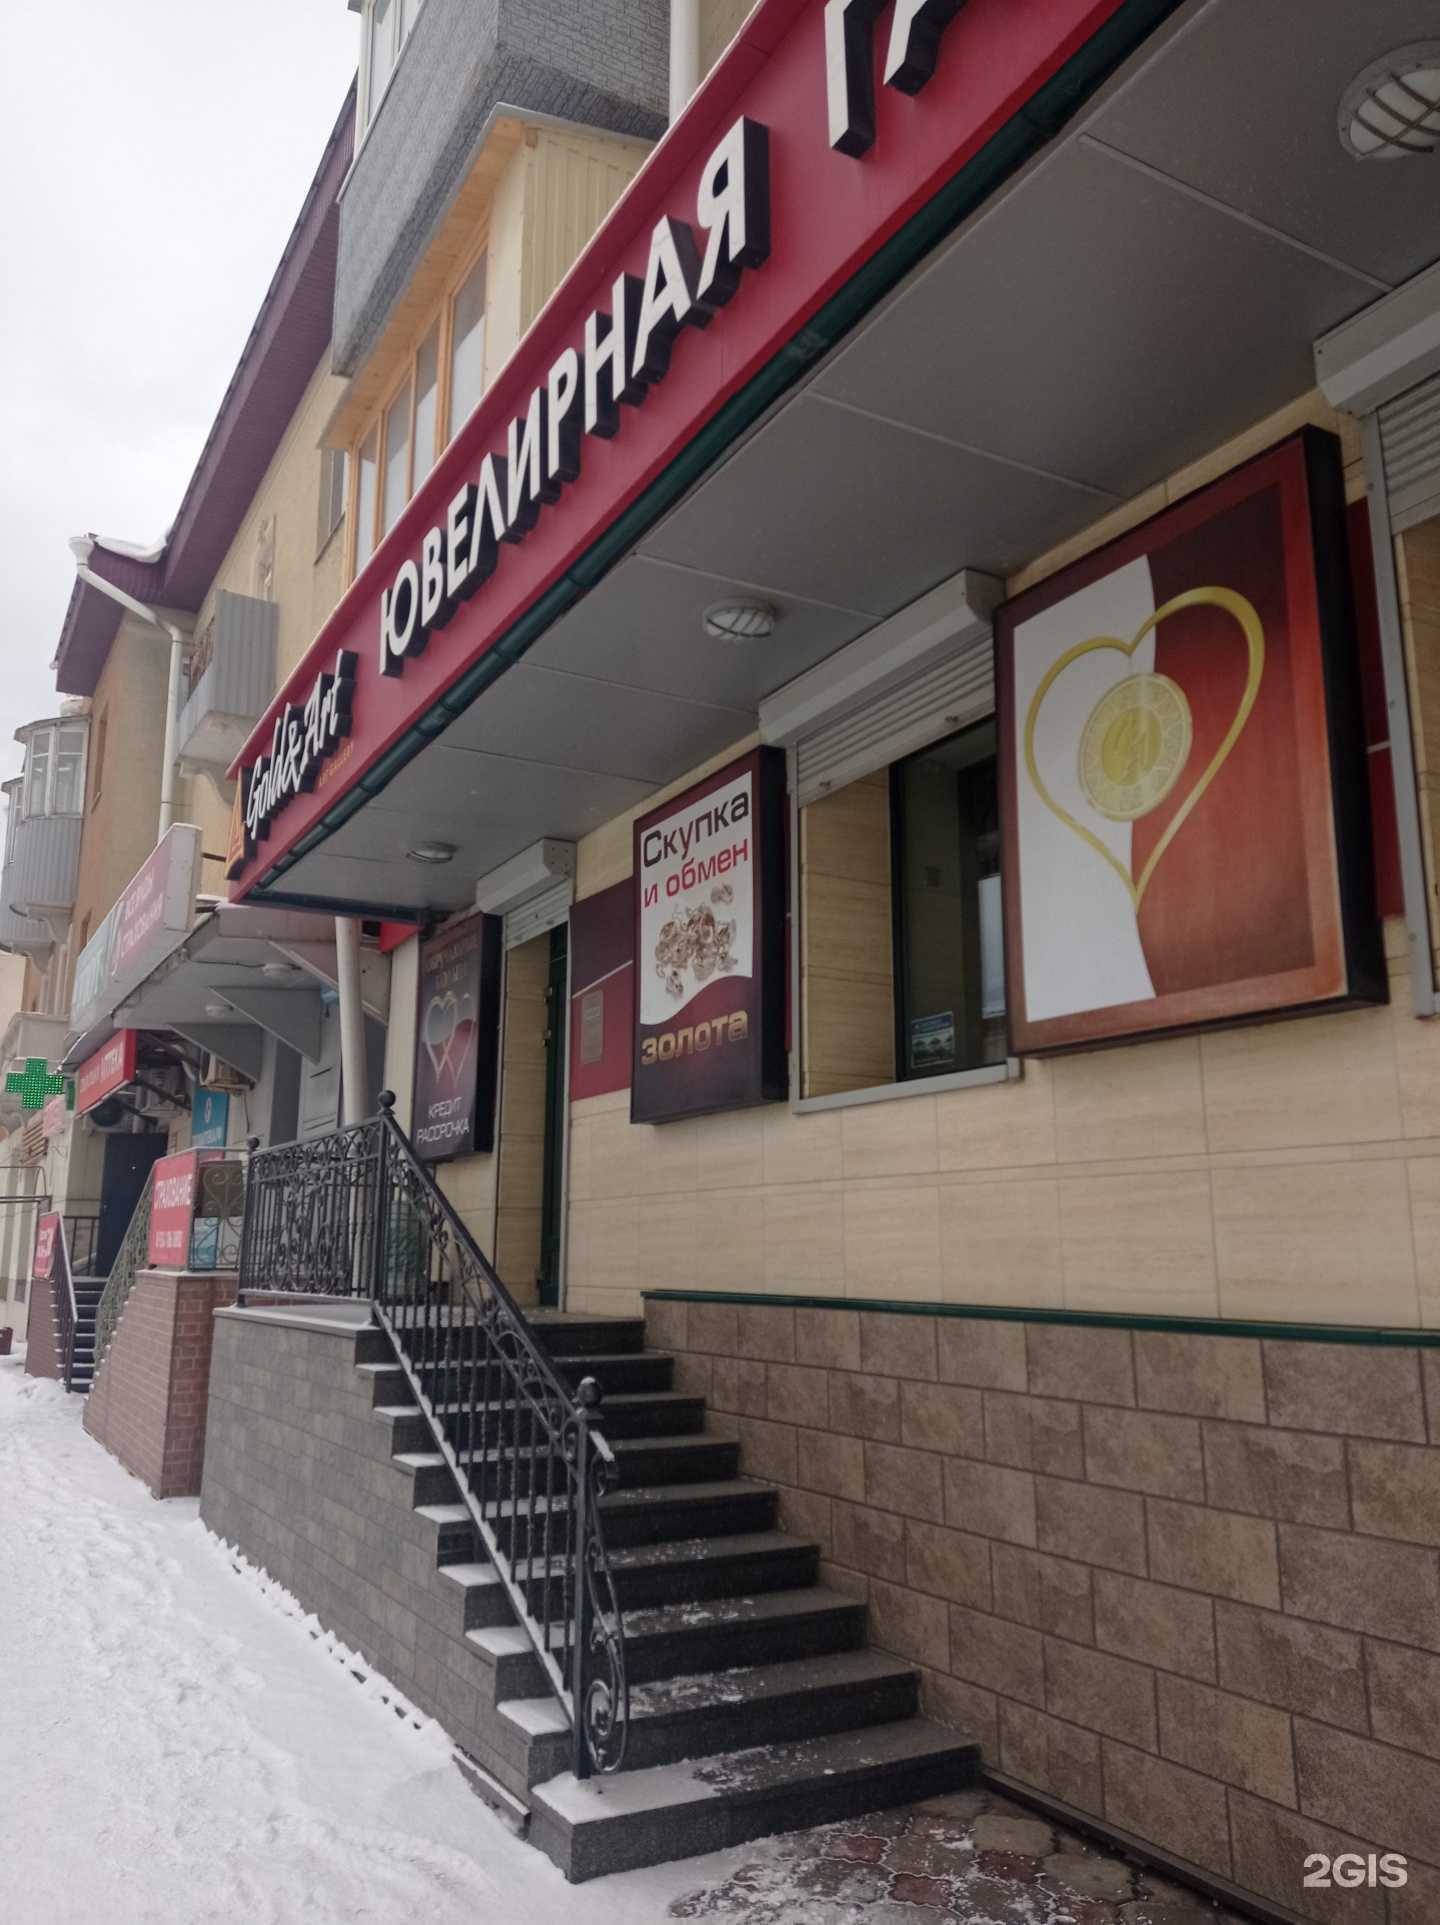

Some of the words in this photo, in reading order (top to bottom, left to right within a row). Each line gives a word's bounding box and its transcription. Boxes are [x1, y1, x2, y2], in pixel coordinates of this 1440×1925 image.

[379, 115, 750, 674] ЮВЕЛИРНАЯ
[643, 791, 749, 868] Скупка
[644, 883, 658, 908] и
[666, 838, 748, 898] обмен
[641, 1009, 748, 1065] золота
[416, 1118, 470, 1144] РАССРОЧКА
[428, 1096, 462, 1119] КРЕДИТ
